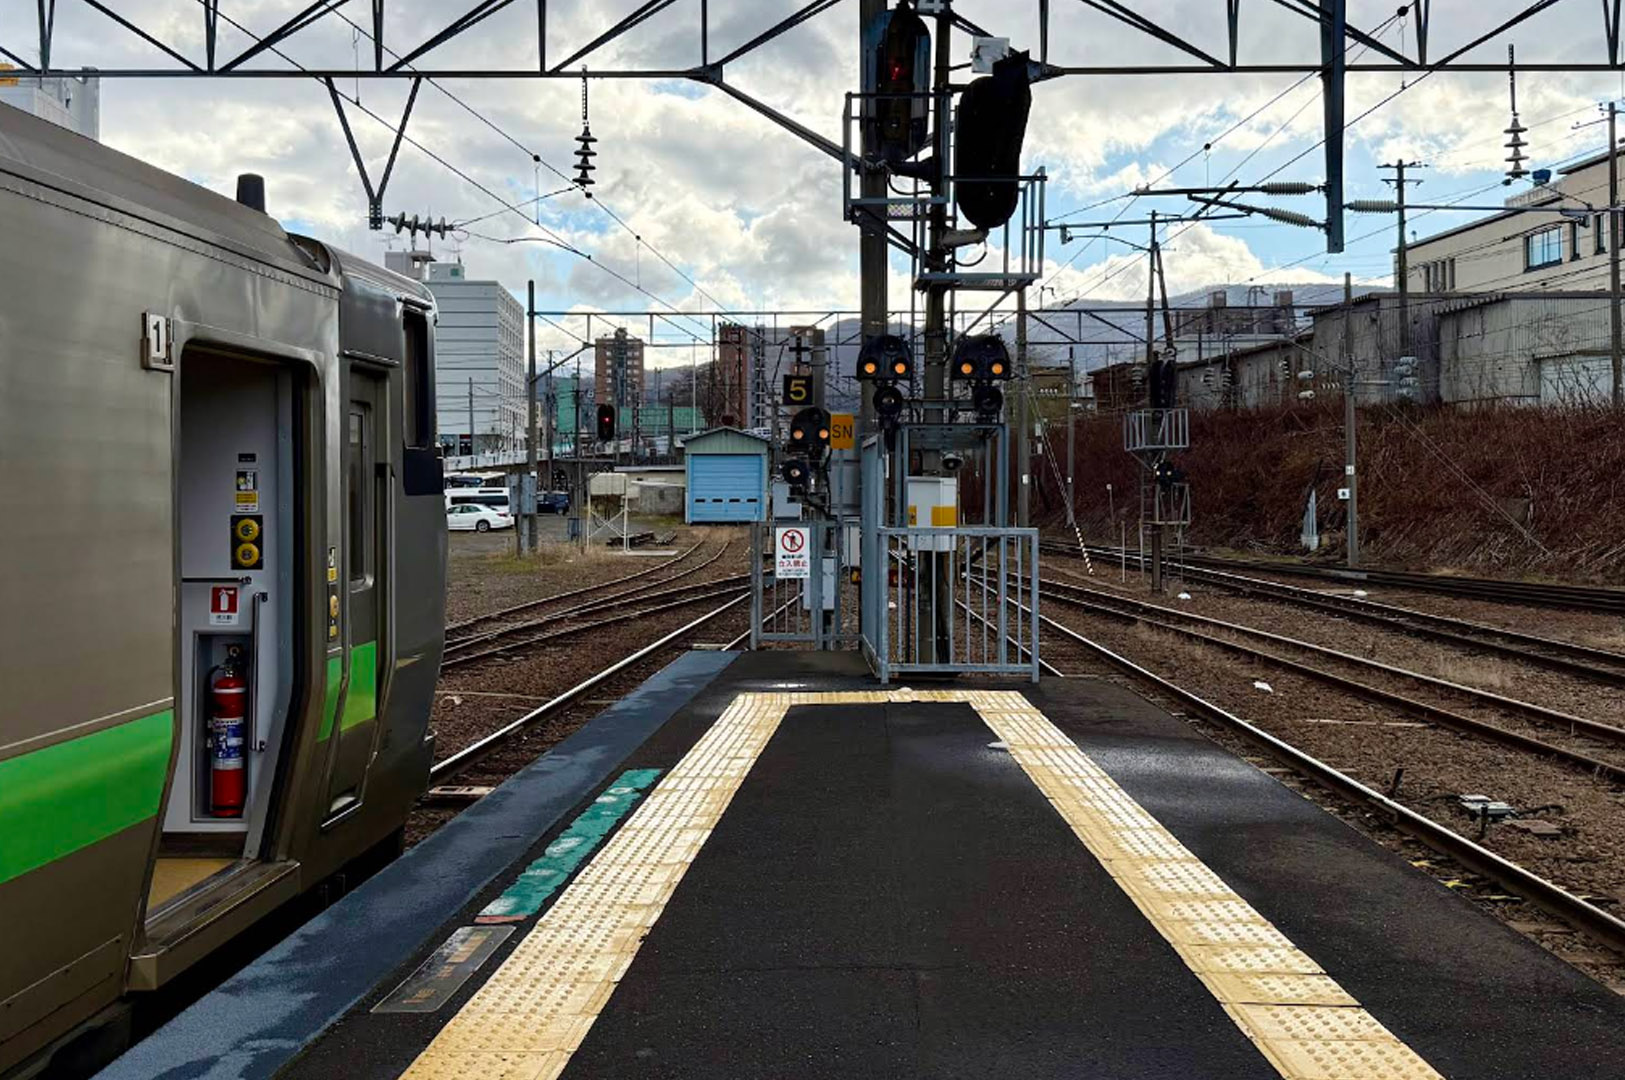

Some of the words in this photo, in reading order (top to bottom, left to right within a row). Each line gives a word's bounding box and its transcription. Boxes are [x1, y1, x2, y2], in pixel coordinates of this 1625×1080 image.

[153, 321, 160, 352] 1
[789, 379, 807, 401] 5
[832, 424, 853, 439] SN
